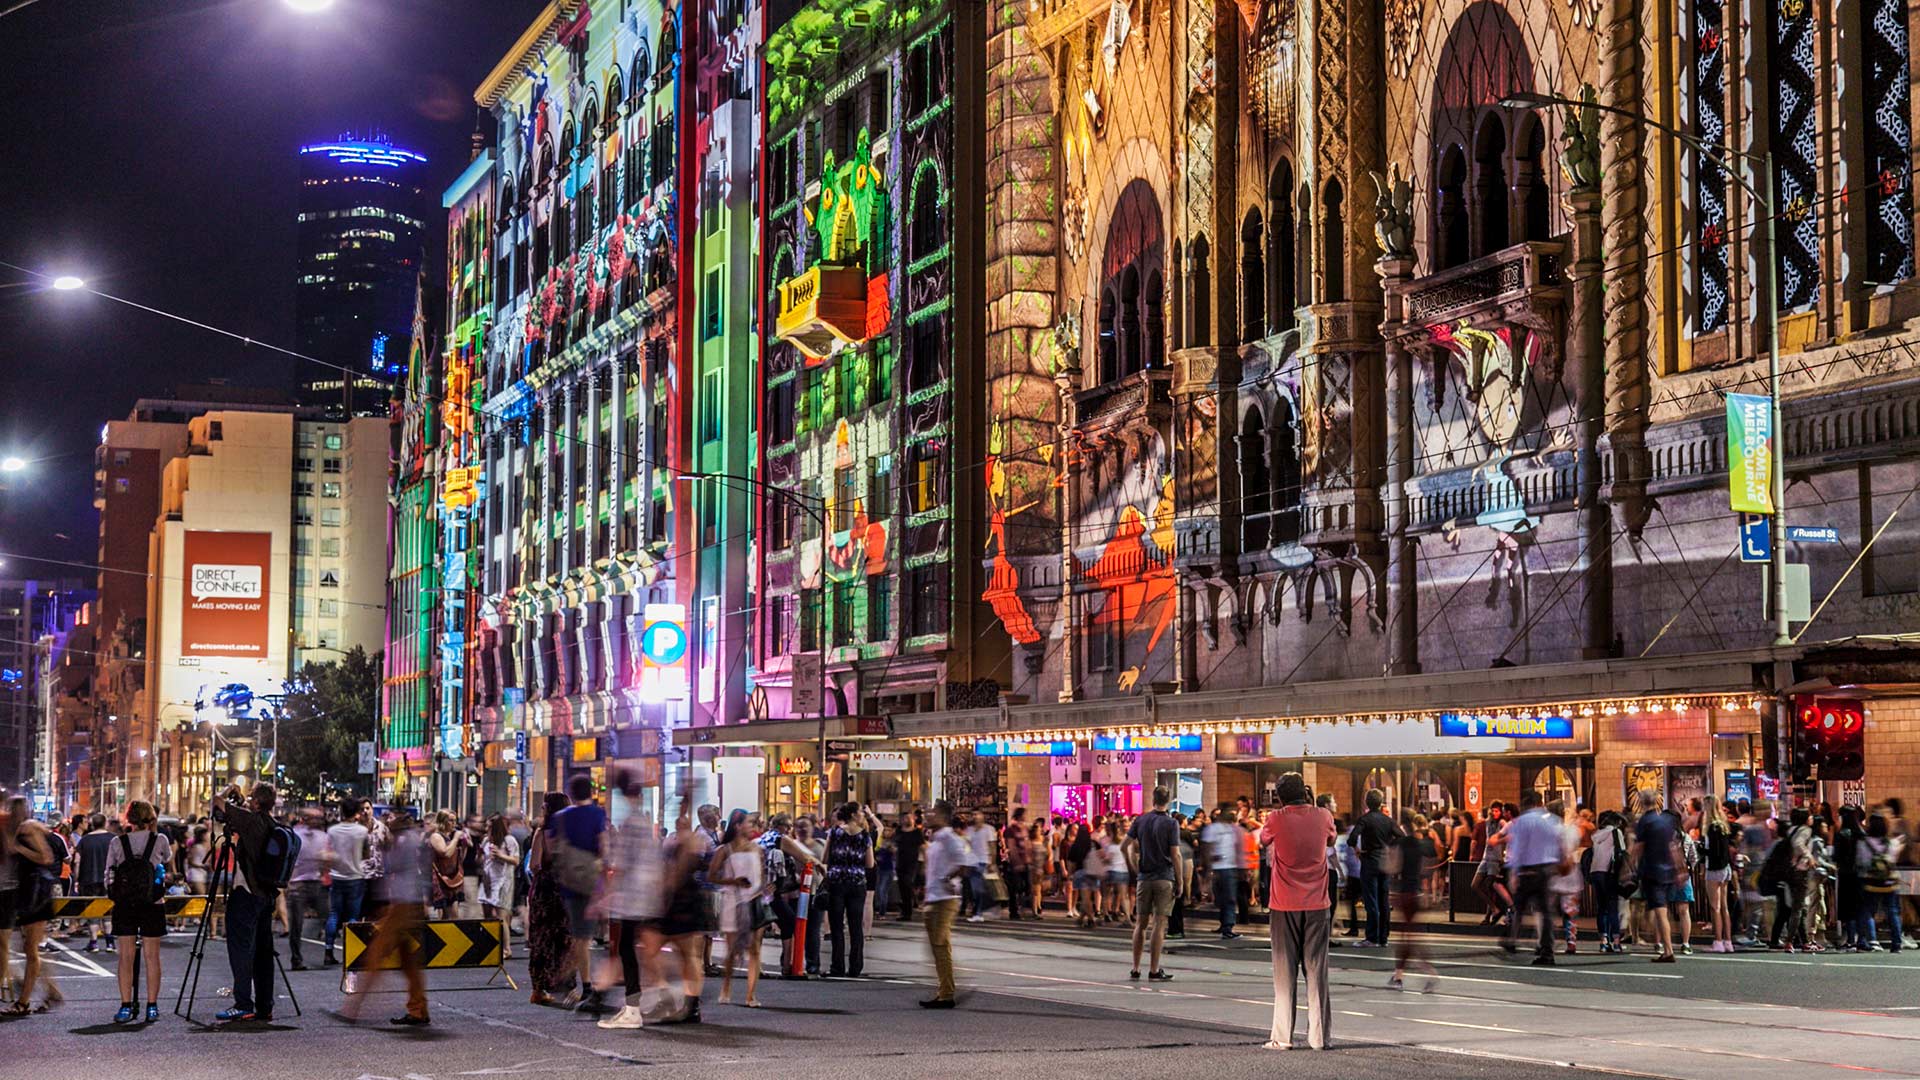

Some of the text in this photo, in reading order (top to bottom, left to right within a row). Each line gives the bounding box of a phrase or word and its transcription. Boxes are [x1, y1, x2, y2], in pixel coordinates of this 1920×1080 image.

[1744, 403, 1757, 503] MELBOURNE
[1755, 403, 1767, 505] WELCOME TO
[1799, 529, 1836, 538] Russell St
[196, 569, 235, 580] DIRECT
[196, 581, 257, 592] CONNECT
[244, 603, 261, 611] EASY
[190, 643, 260, 651] directconnect.com.au
[653, 627, 678, 656] P
[1486, 718, 1547, 735] FORUM
[1117, 752, 1136, 764] FOOD
